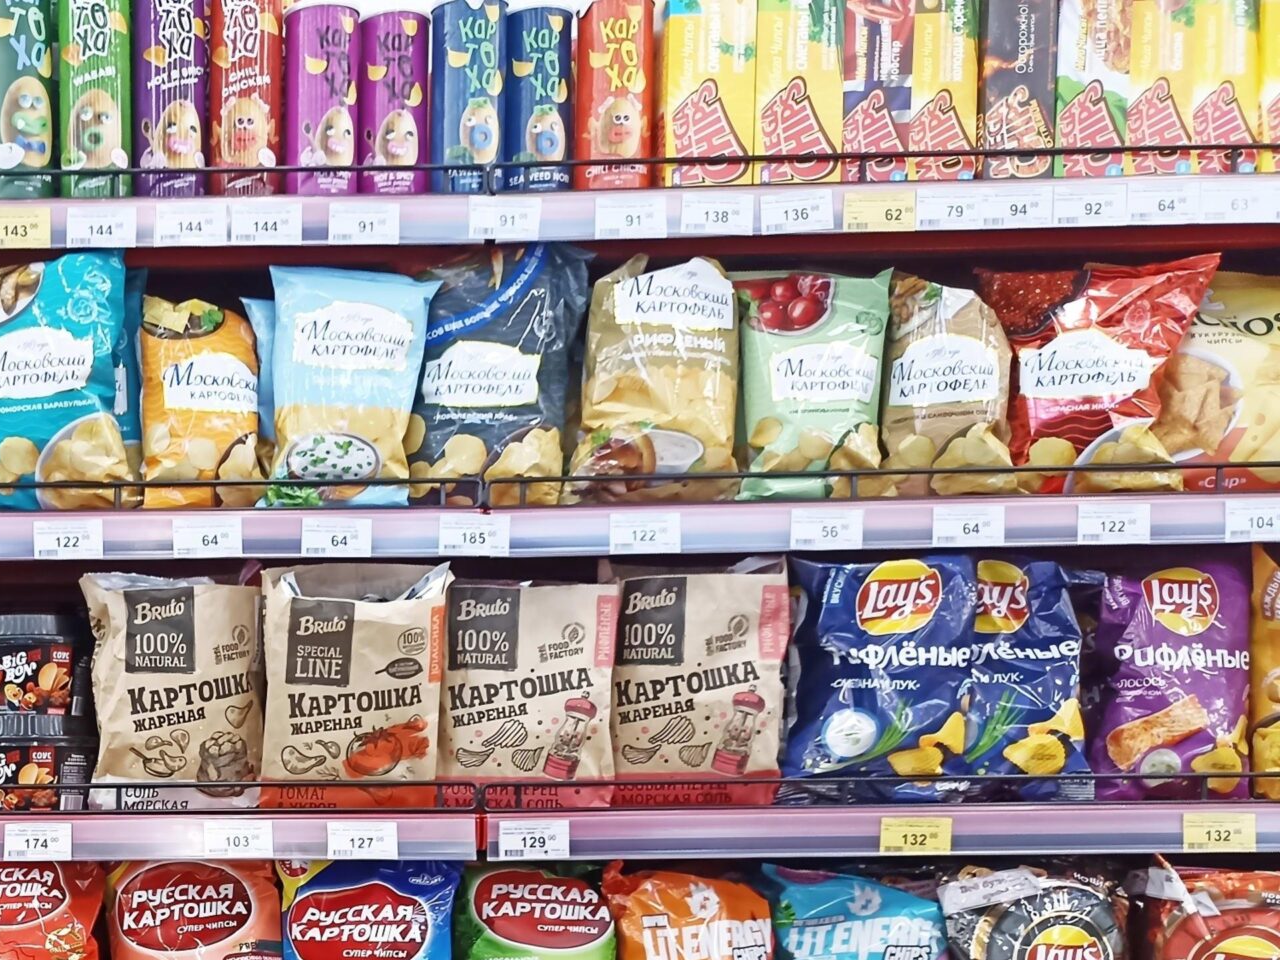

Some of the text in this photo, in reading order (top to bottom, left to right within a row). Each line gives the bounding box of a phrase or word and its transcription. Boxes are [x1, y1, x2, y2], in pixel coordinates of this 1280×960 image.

[886, 209, 902, 220] 62
[1010, 204, 1027, 216] 94
[705, 211, 728, 223] 138
[4, 225, 27, 237] 143
[90, 225, 112, 235] 144
[255, 221, 277, 232] 144
[635, 301, 725, 320] КАРТОФЕЛЬ
[302, 319, 407, 348] Московский
[896, 360, 994, 383] Московский
[963, 523, 979, 534] 64
[1101, 521, 1125, 532] 122
[56, 537, 79, 547] 122
[202, 535, 218, 546] 64
[332, 536, 347, 546] 64
[463, 533, 485, 544] 185
[858, 576, 940, 621] Lay's
[134, 633, 186, 655] 100%
[297, 645, 341, 658] SPECIAL
[135, 655, 186, 667] NATURAL
[296, 658, 341, 679] LINE
[288, 684, 421, 719] КАРТОШКА
[133, 707, 206, 732] ЖАРЕНАЯ
[903, 834, 927, 845] 132
[1206, 830, 1230, 841] 132
[25, 839, 48, 848] 174
[350, 838, 373, 848] 127
[522, 837, 545, 848] 129
[132, 884, 234, 907] РУССКАЯ
[491, 884, 599, 904] РУССКАЯ
[123, 901, 247, 929] КАРТОШКА
[301, 904, 414, 924] РУССКАЯ
[481, 901, 610, 921] КАРТОШКА
